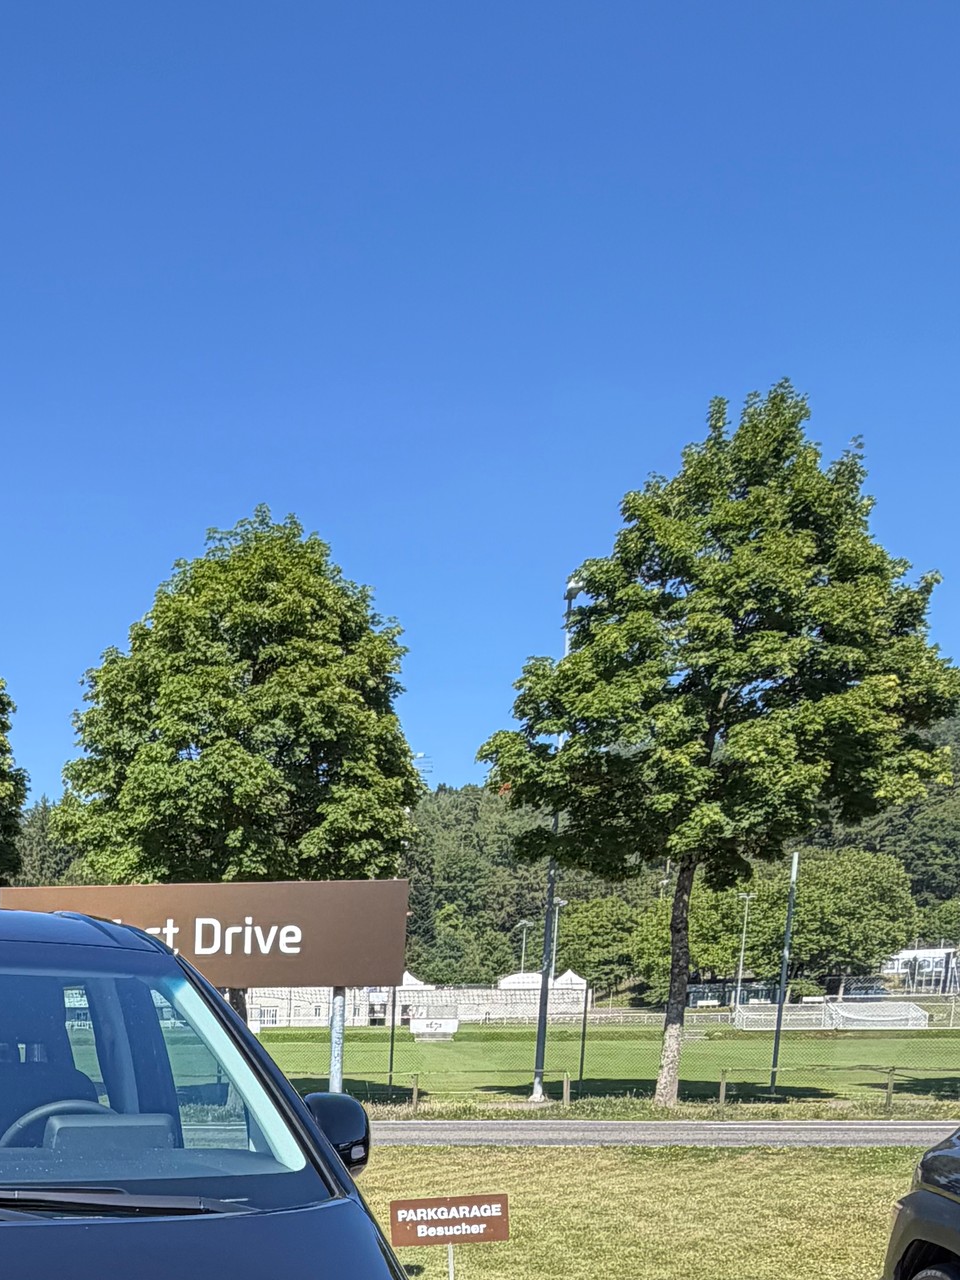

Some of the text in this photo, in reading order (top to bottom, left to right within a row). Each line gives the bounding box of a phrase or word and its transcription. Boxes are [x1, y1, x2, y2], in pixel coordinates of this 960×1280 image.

[194, 916, 302, 955] Drive
[397, 1204, 502, 1222] PARKGARAGE
[417, 1222, 487, 1237] Besucher
